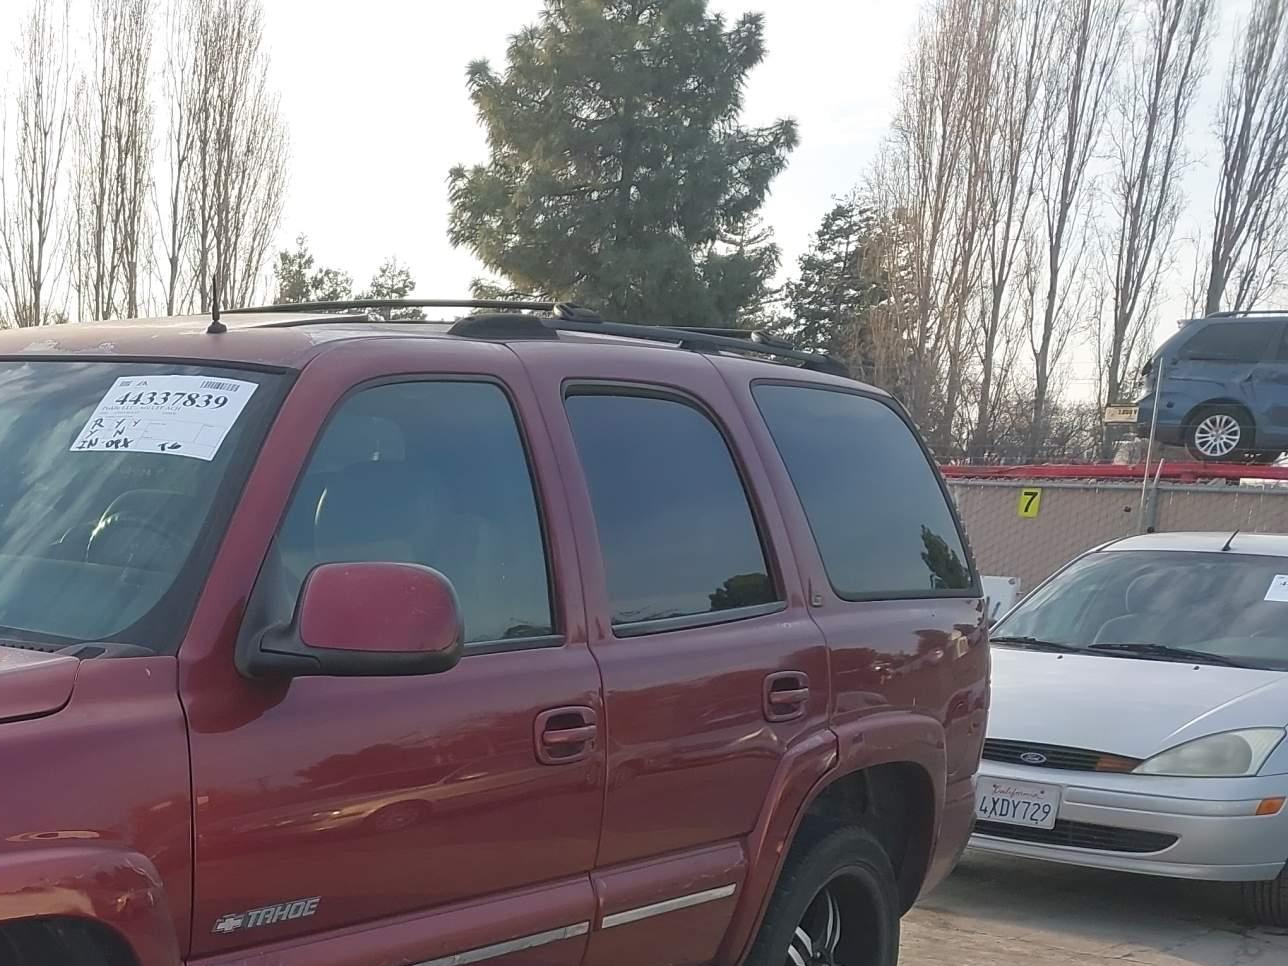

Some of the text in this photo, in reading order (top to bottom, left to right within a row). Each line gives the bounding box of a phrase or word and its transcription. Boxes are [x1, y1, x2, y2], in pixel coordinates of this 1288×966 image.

[115, 391, 228, 410] 44337839
[1023, 491, 1039, 513] 7
[979, 795, 1052, 822] 4XDY729
[246, 897, 321, 928] TAHOE
